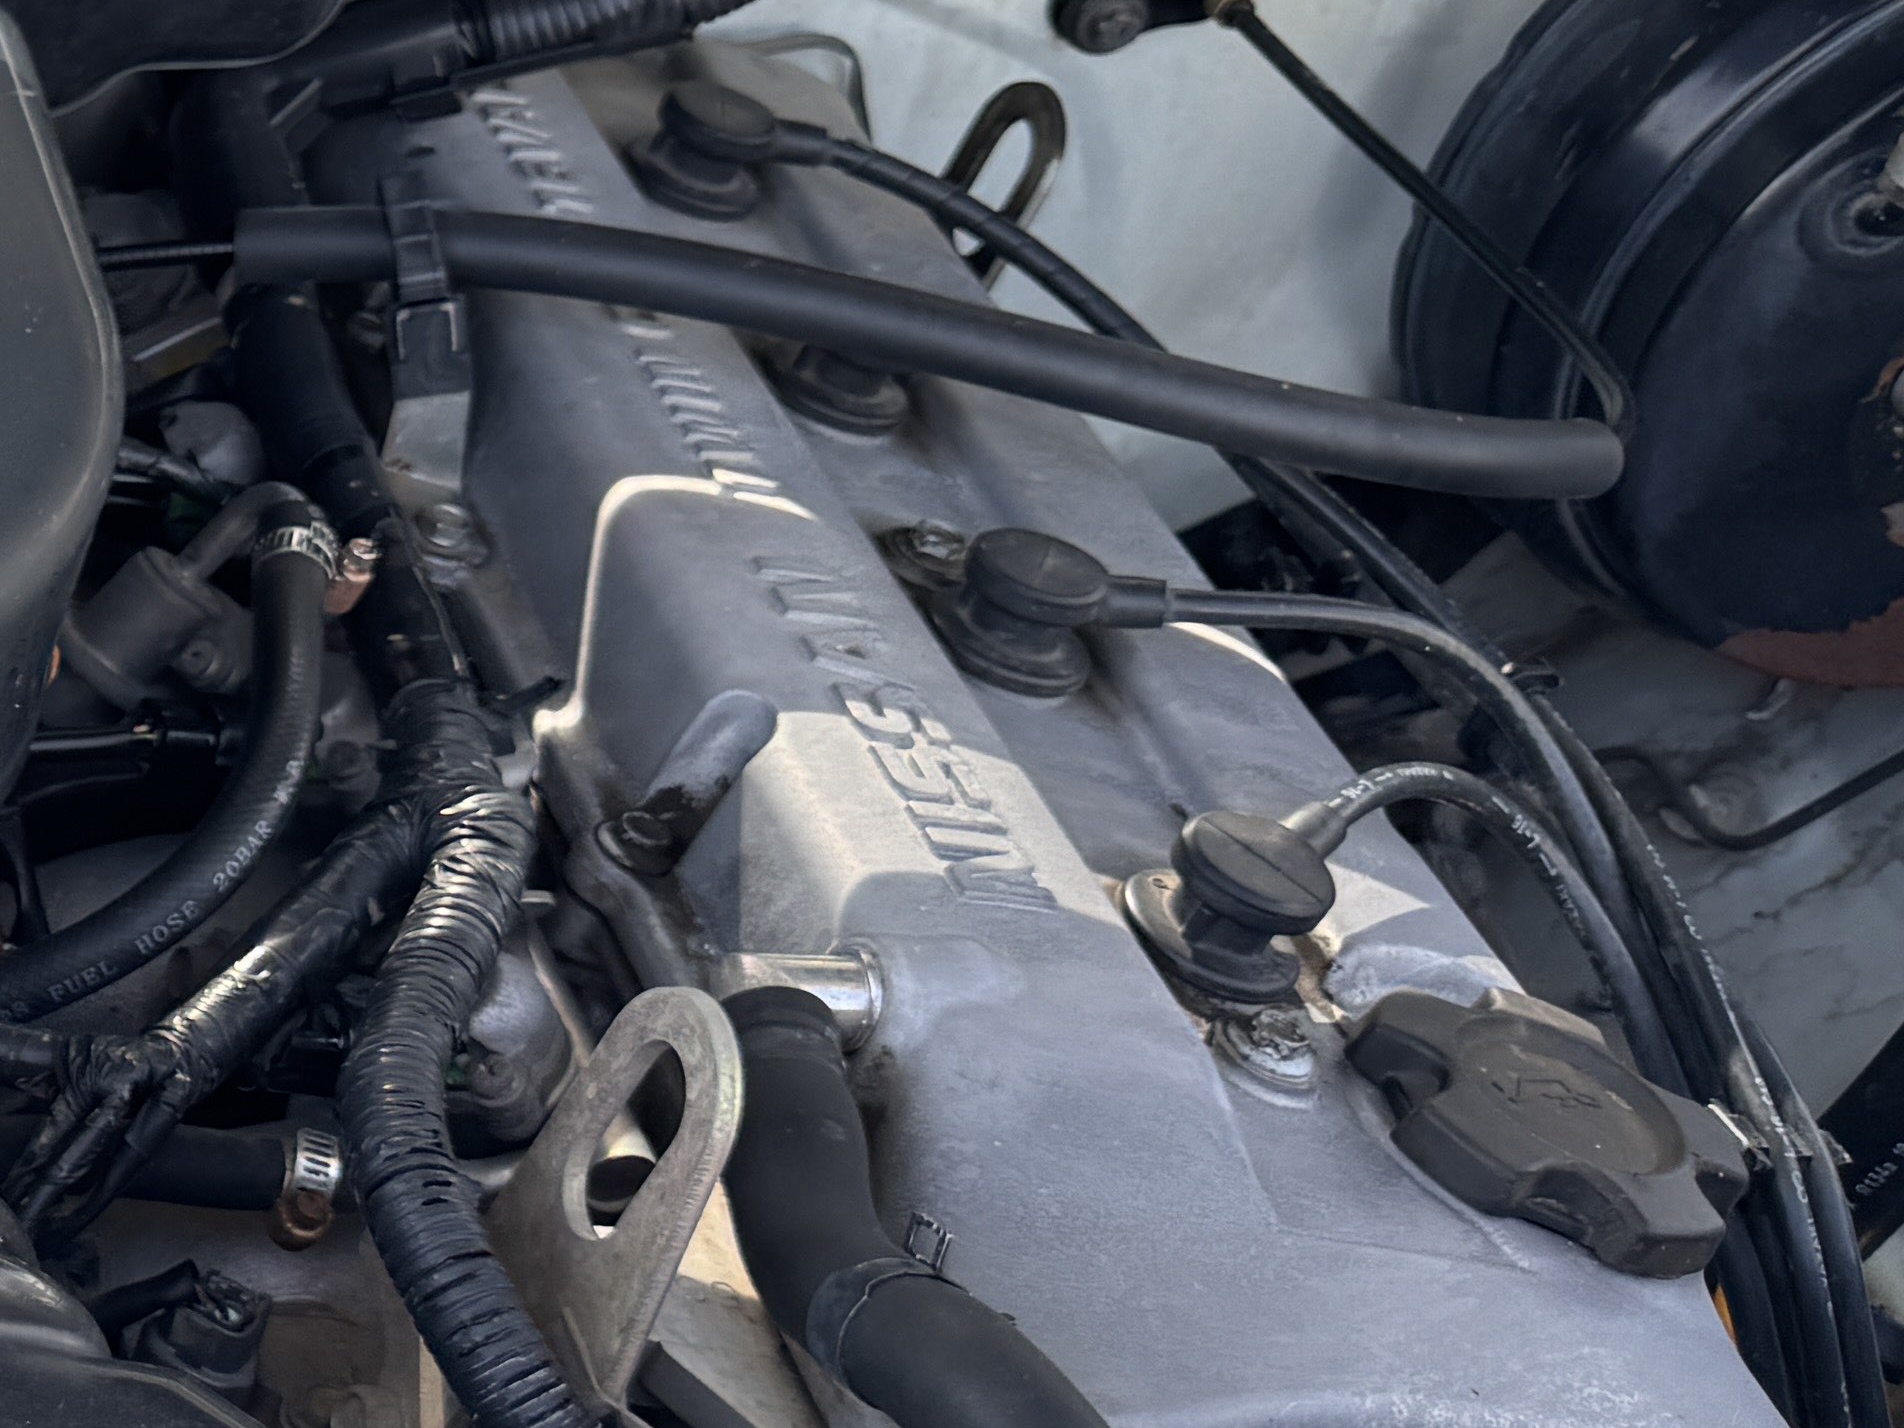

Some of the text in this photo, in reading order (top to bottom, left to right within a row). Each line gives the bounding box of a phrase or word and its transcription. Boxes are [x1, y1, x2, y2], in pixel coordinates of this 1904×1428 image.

[751, 555, 1058, 913] NISSAN
[48, 961, 117, 1000] FUEL
[135, 901, 199, 954] HOSE
[212, 820, 273, 892] 20BAR
